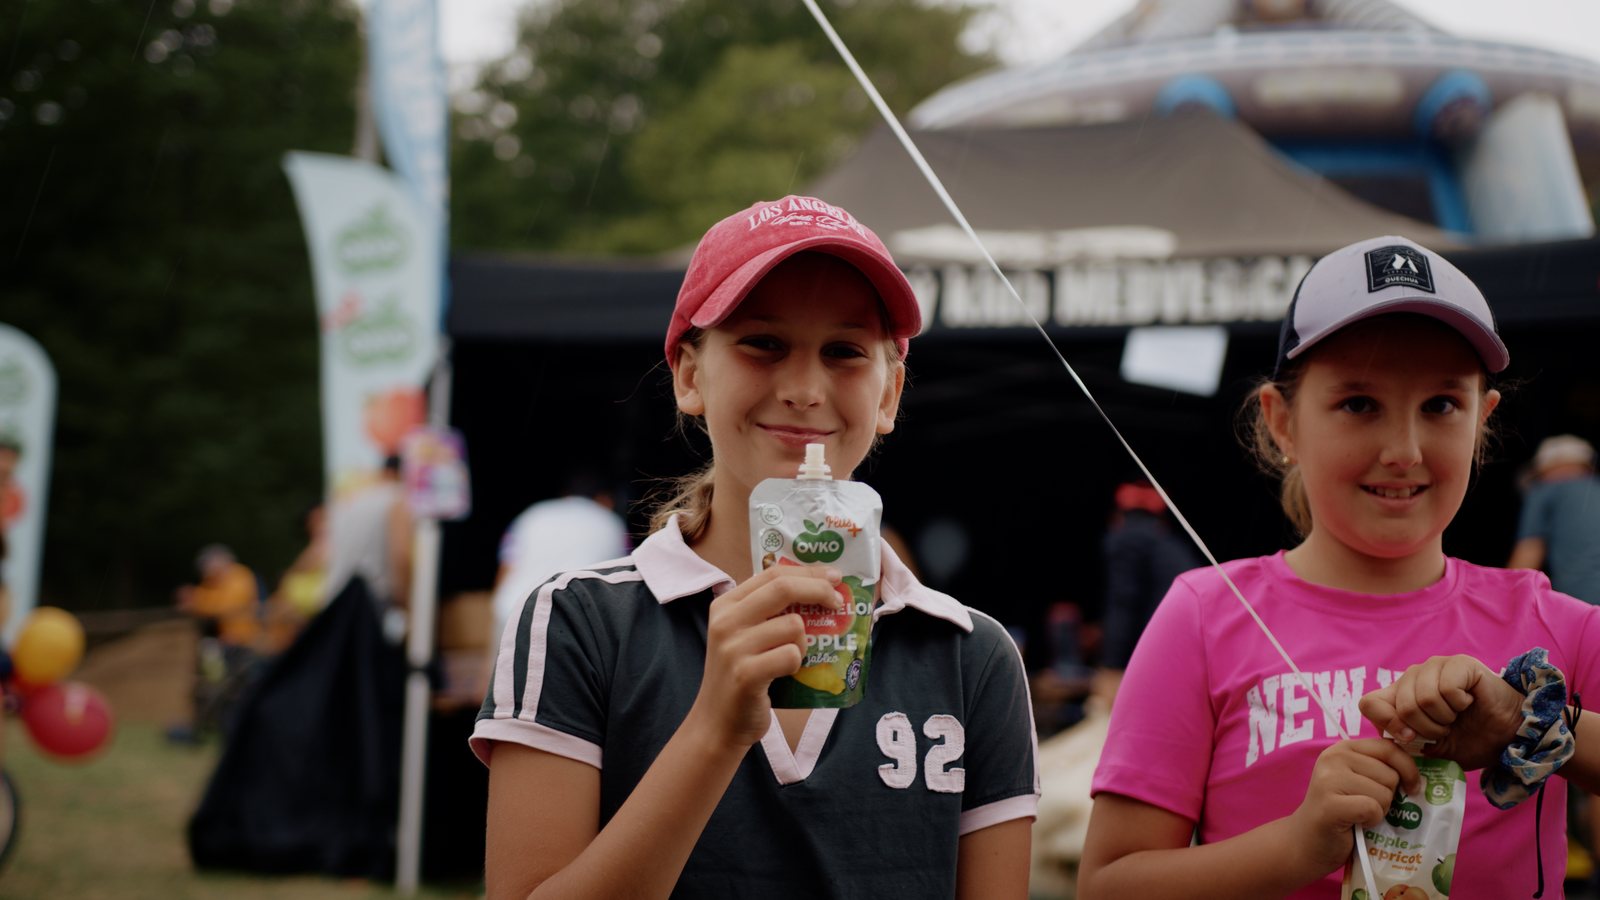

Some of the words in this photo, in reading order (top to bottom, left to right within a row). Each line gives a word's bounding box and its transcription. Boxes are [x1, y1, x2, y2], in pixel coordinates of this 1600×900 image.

[748, 204, 783, 232] LOS
[1384, 276, 1419, 285] QUECHUA
[796, 540, 840, 554] OVKO
[803, 633, 857, 651] PPLE
[1246, 666, 1366, 768] NEW
[876, 711, 965, 793] 92
[1389, 807, 1420, 821] OVKO
[1364, 830, 1409, 849] apple
[1368, 847, 1423, 865] apricot
